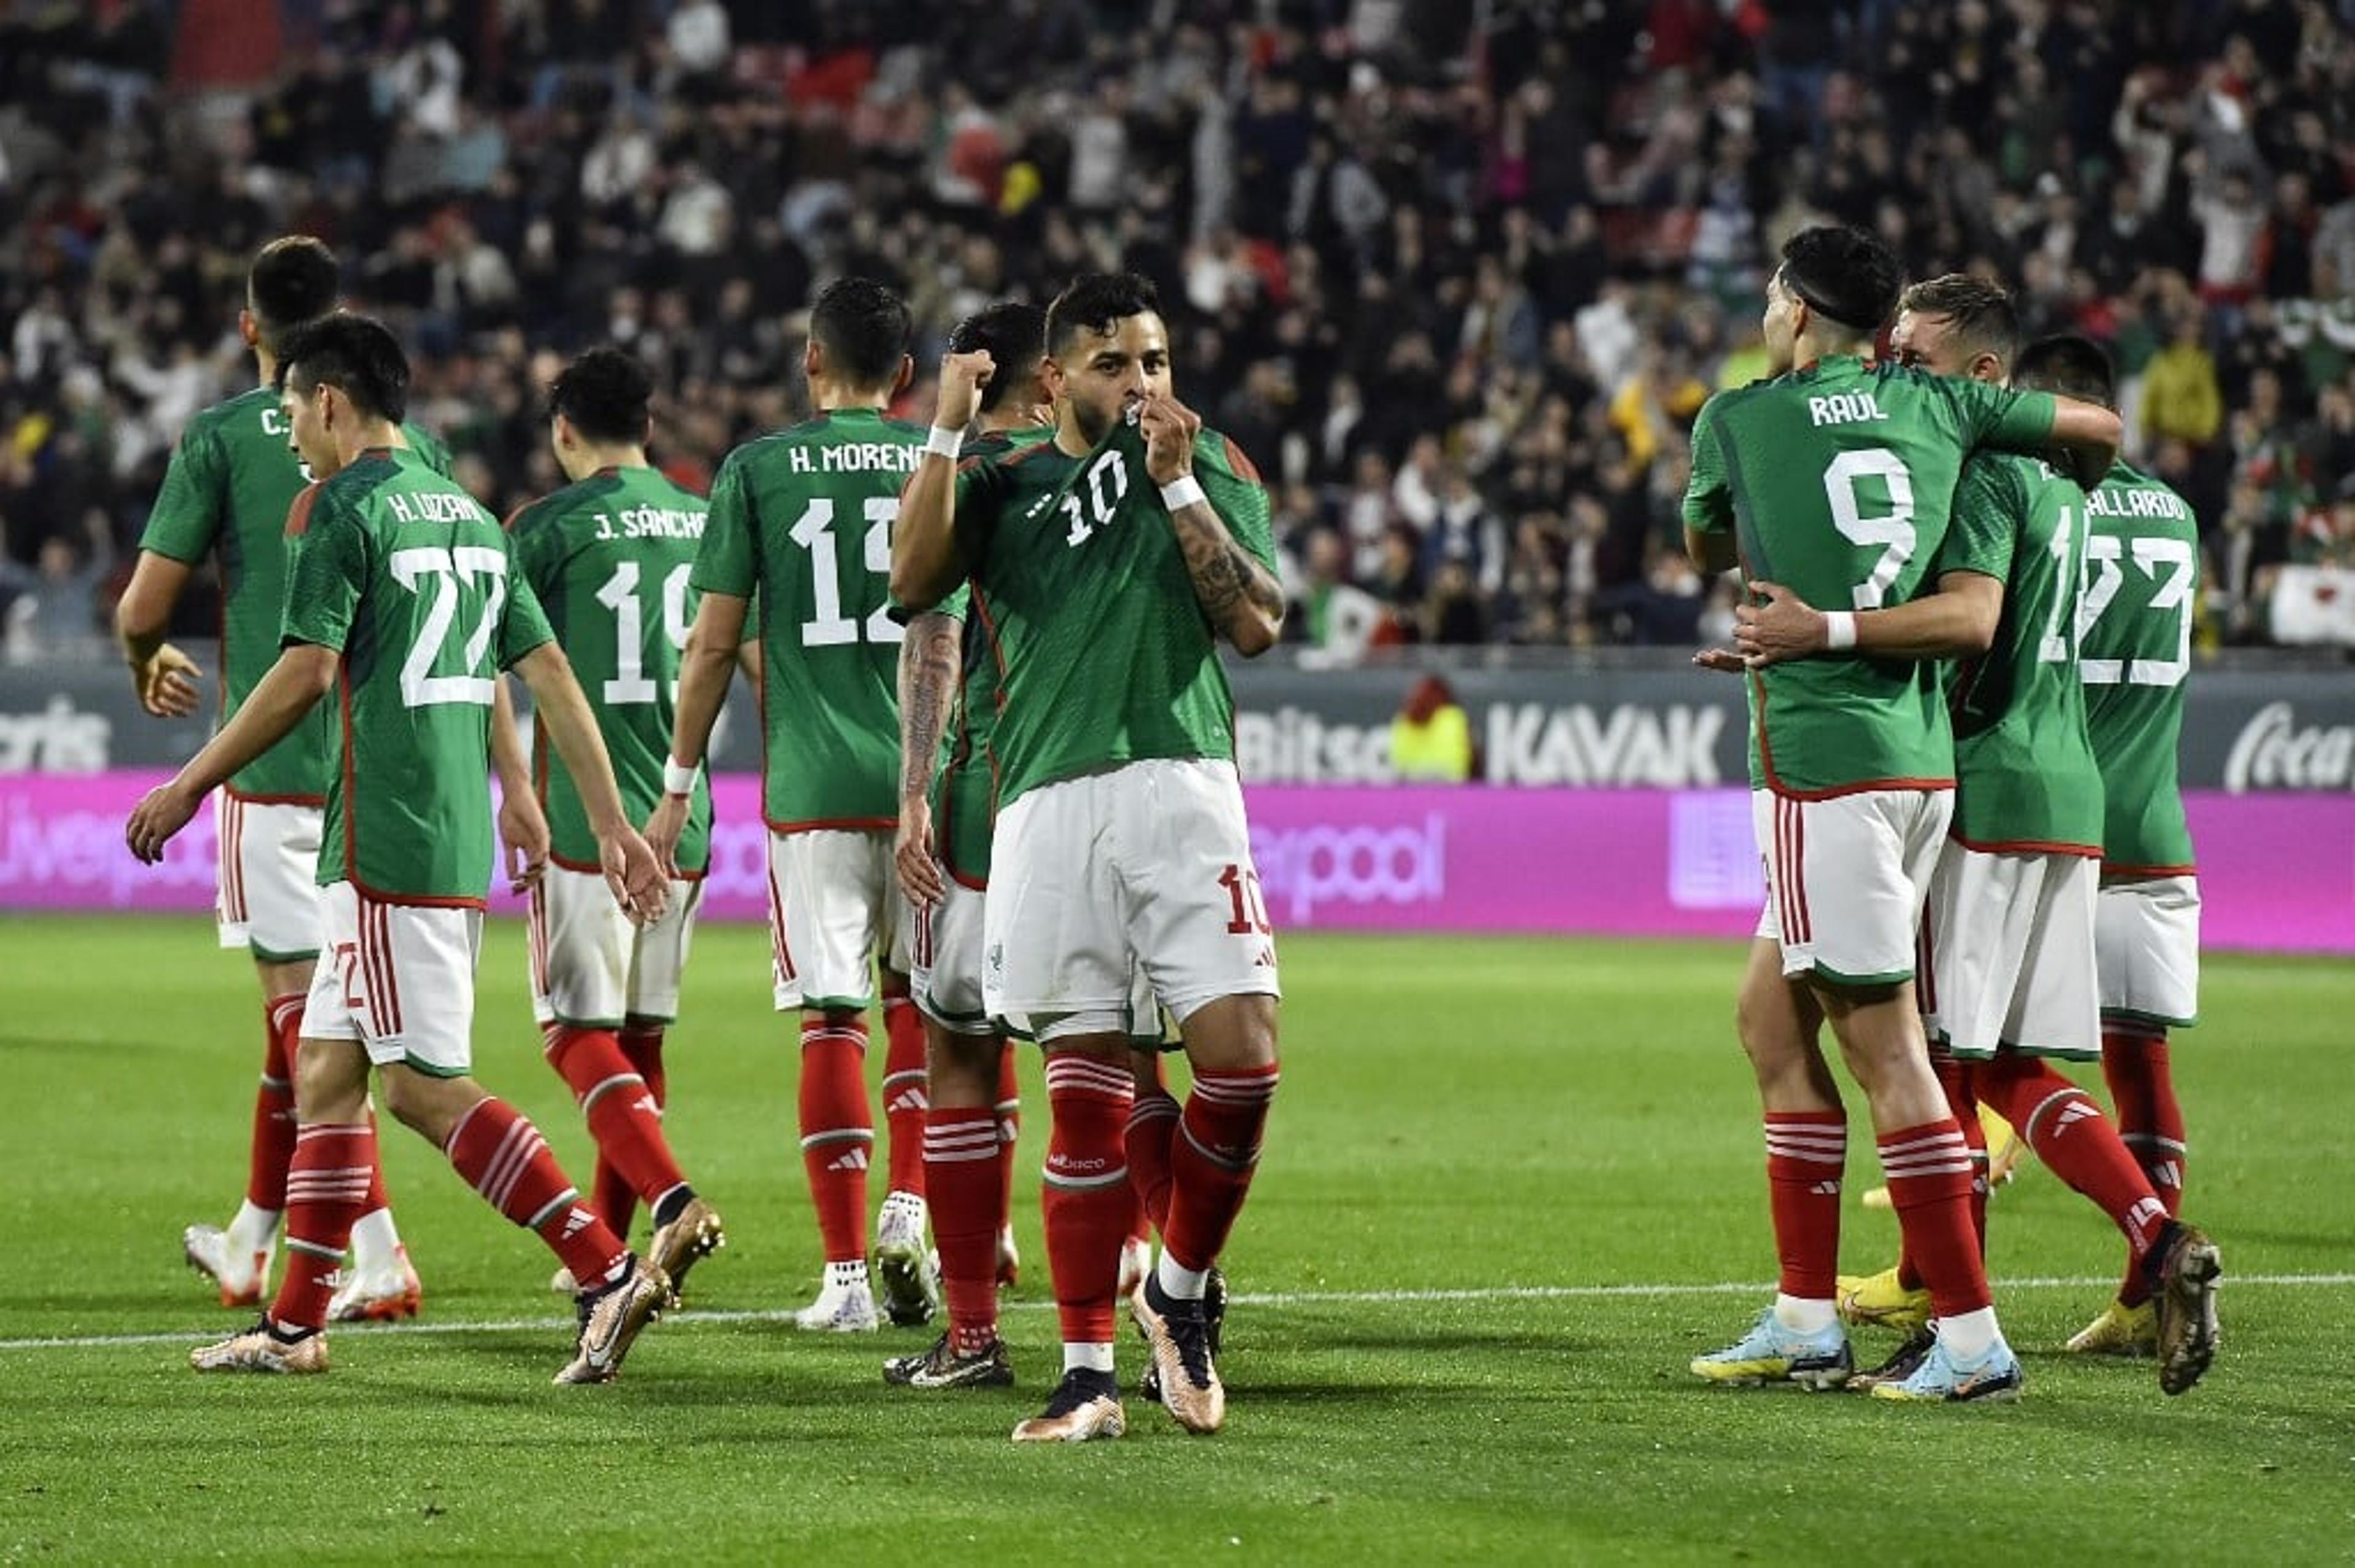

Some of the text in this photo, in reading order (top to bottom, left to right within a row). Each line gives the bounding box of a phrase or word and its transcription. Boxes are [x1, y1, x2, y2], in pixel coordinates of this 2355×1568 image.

[1809, 388, 1889, 426] RAÚL
[790, 446, 818, 474] H.
[387, 492, 486, 526] H. LOZAN
[593, 514, 620, 540] J.
[1060, 449, 1128, 548] 10
[2086, 489, 2186, 521] ALLARDO
[1823, 448, 1917, 610] 9
[390, 546, 507, 708] 22
[2077, 535, 2194, 686] 23
[1487, 703, 1725, 786] KAVAK
